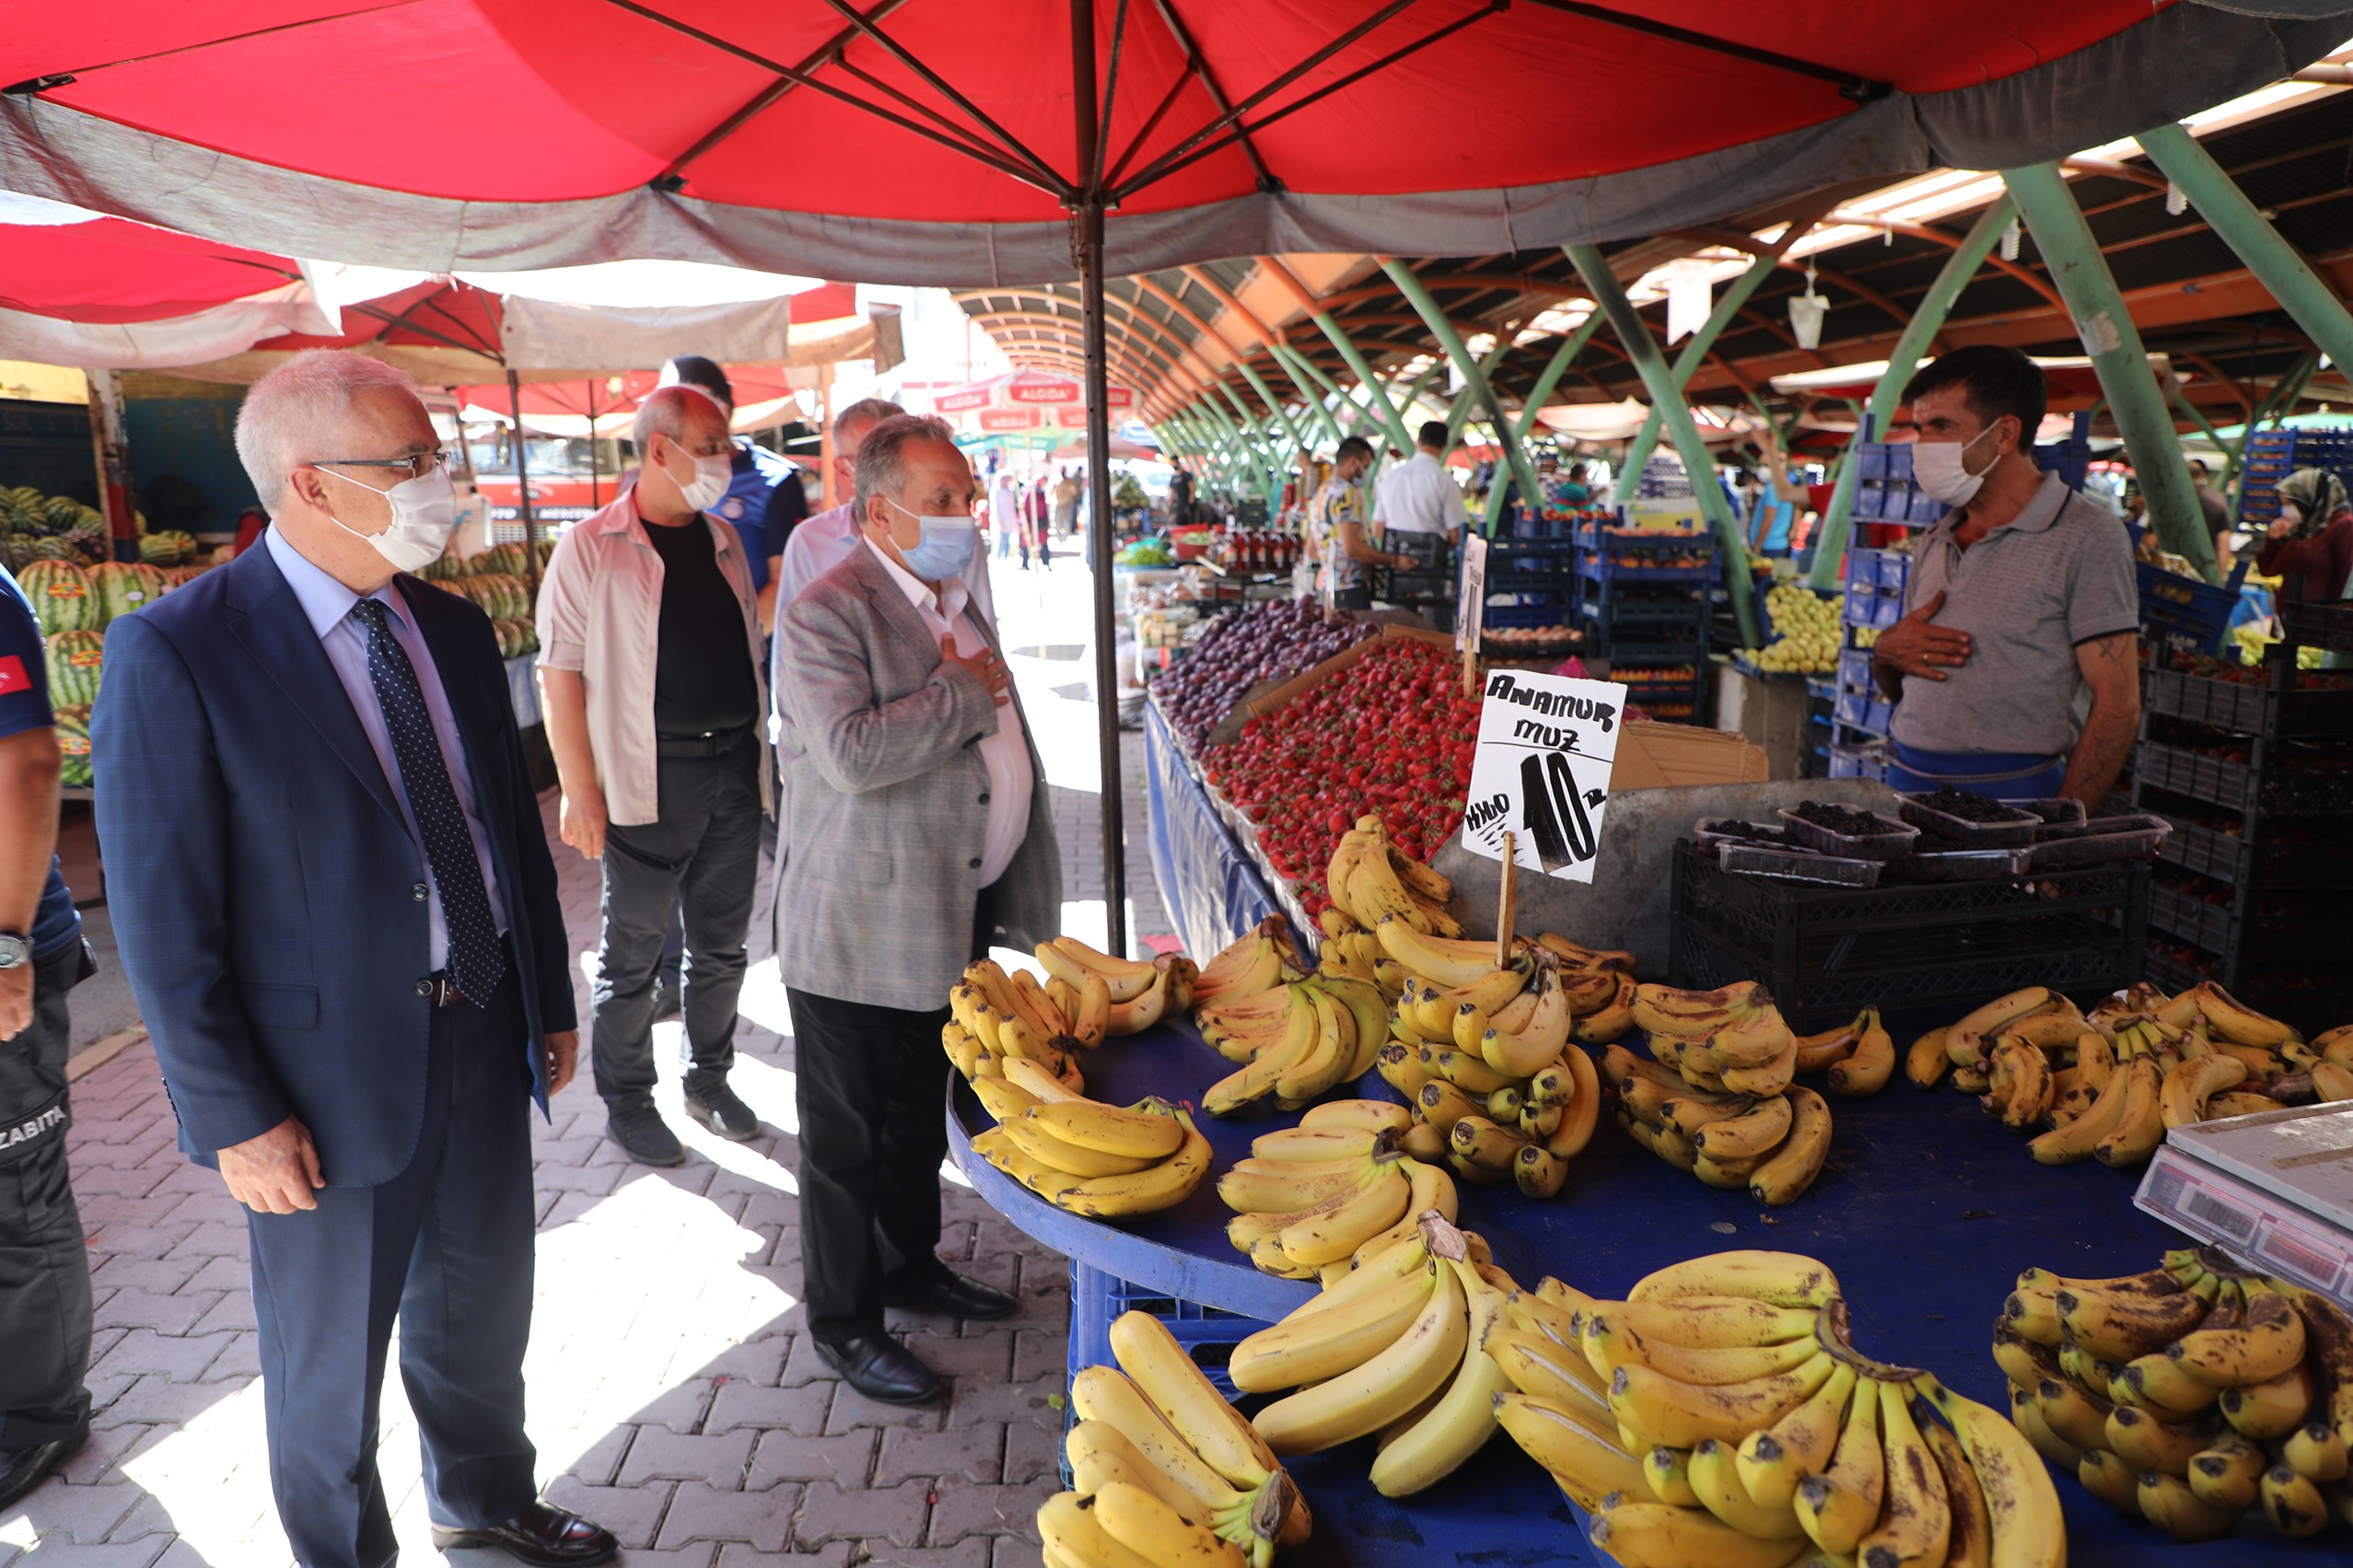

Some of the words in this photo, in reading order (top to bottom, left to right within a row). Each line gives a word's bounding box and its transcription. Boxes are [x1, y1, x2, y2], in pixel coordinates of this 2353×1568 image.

[1019, 387, 1068, 400] ALGIDA
[1486, 675, 1616, 733] ANAMUR
[1513, 719, 1580, 752] MUZ
